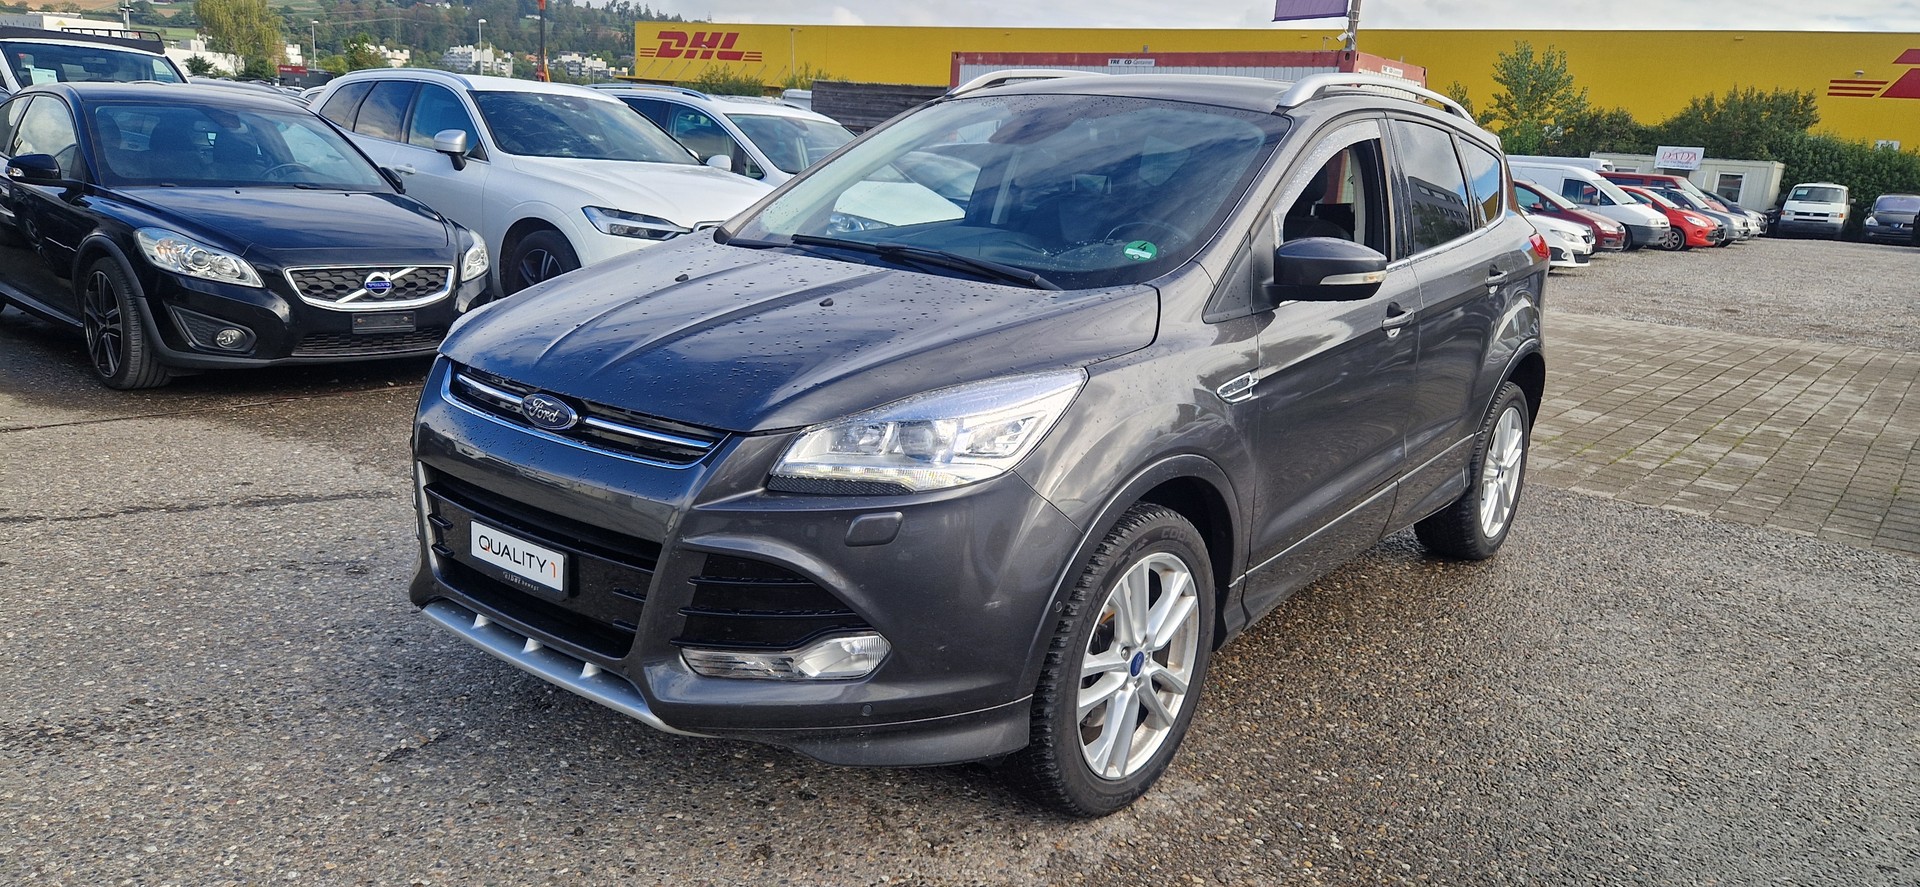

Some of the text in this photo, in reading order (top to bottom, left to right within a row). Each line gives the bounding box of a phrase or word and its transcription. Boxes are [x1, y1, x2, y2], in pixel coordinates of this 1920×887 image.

[655, 31, 745, 61] DHL
[1137, 242, 1147, 251] 4
[529, 398, 560, 423] Ford
[478, 534, 556, 578] QUALITY 1
